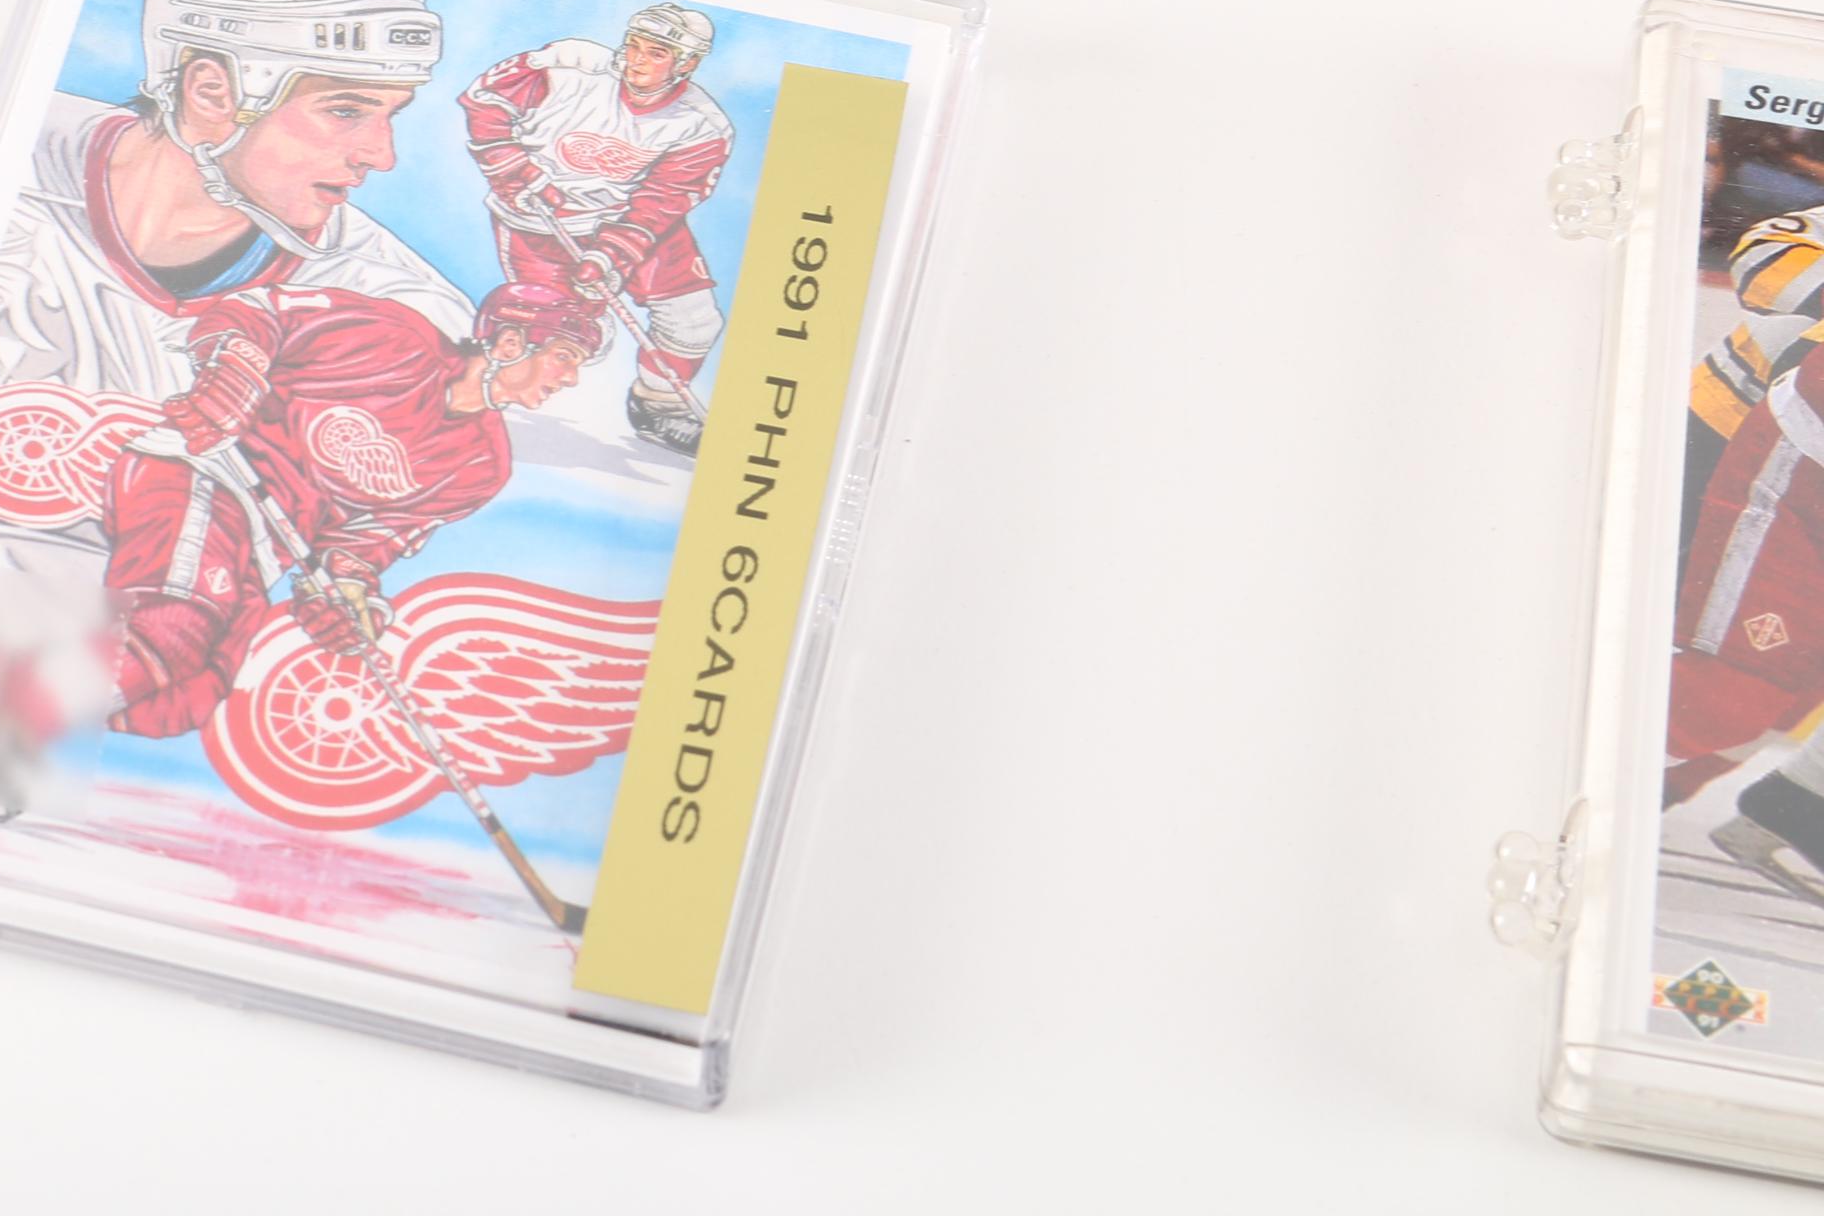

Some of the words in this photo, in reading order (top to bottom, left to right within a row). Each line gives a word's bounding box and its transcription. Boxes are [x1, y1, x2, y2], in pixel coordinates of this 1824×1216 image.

[390, 30, 431, 45] CCM
[776, 204, 834, 342] 1991
[735, 375, 799, 520] PHN
[662, 545, 759, 845] 6CARDS
